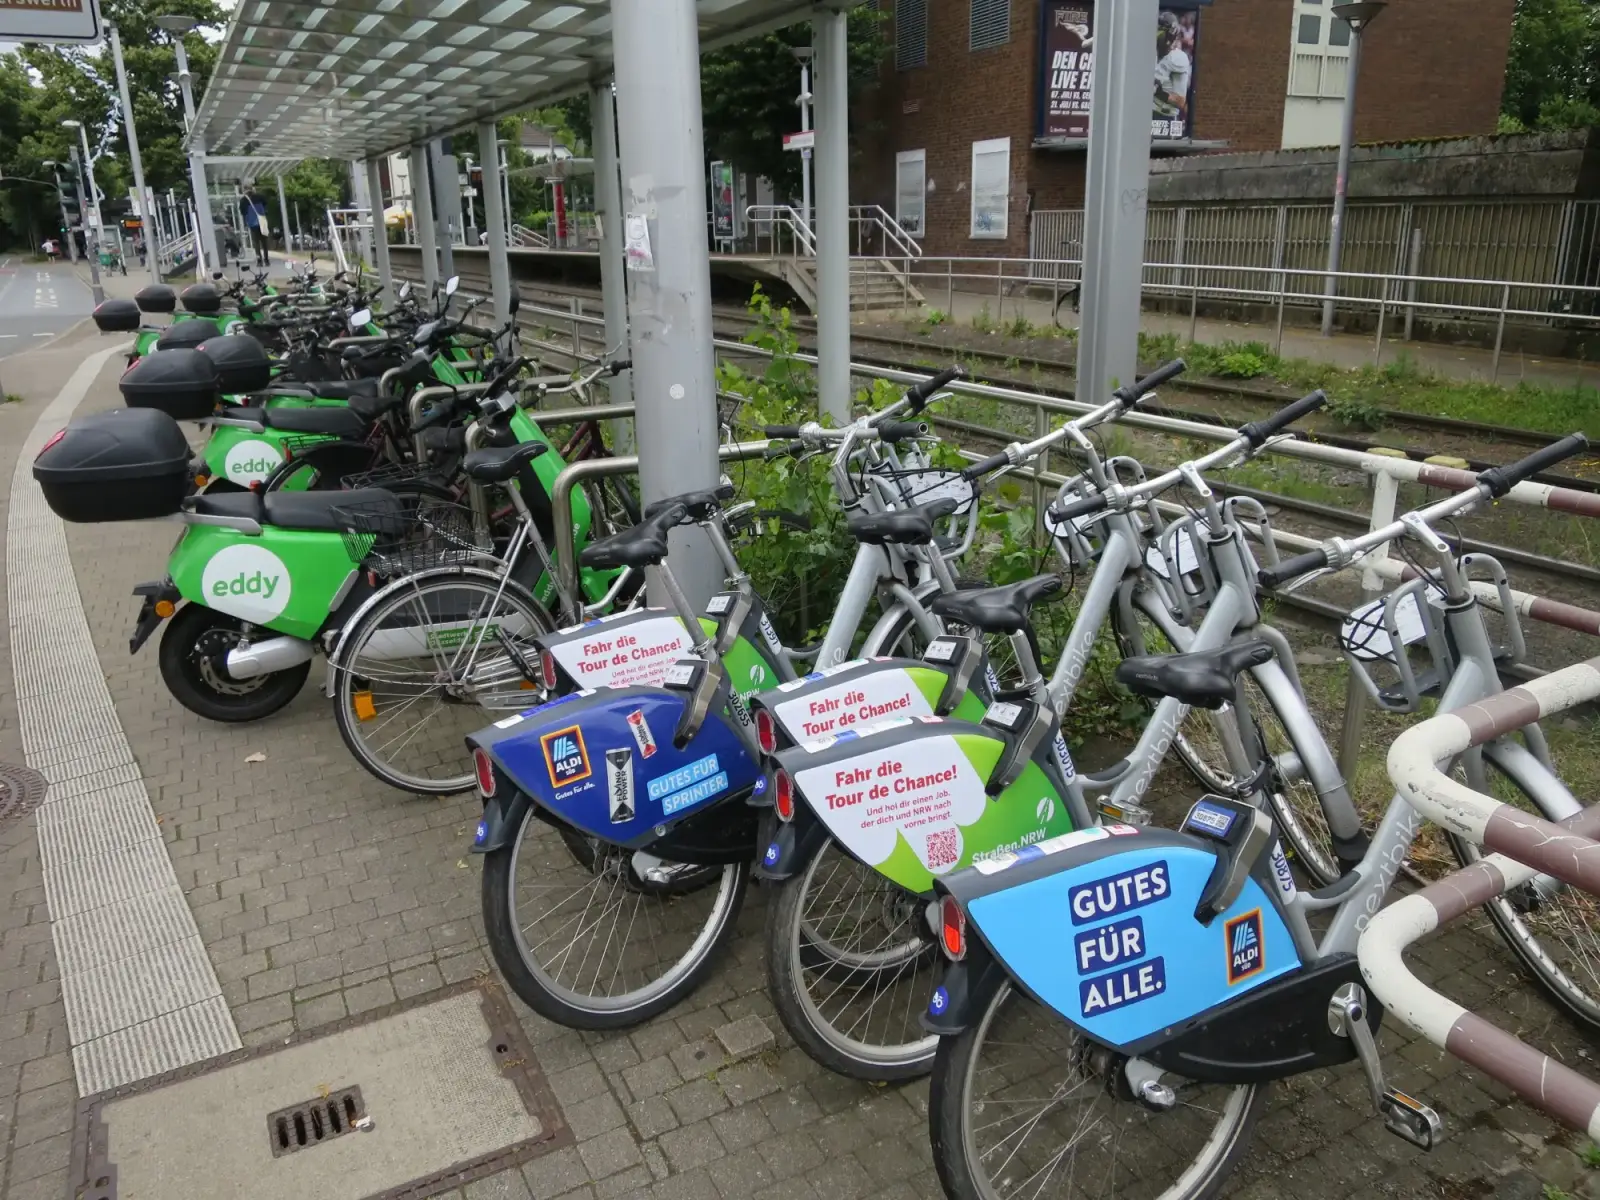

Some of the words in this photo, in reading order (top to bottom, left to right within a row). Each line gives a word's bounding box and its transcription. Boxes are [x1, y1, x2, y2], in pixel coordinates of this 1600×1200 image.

[1052, 51, 1078, 69] DEN
[1051, 70, 1079, 89] LIVE
[231, 458, 277, 476] eddy
[212, 570, 279, 599] eddy
[583, 641, 612, 656] Fahr
[616, 636, 637, 648] die
[761, 620, 779, 645] 31391
[577, 660, 608, 674] Tour
[612, 654, 628, 666] de
[631, 638, 682, 660] Chance!
[1055, 631, 1095, 716] extbike
[728, 691, 751, 727] 302655
[802, 719, 835, 736] Tour
[838, 713, 856, 726] de
[859, 693, 911, 720] Chance!
[809, 699, 840, 716] Fahr
[844, 691, 865, 706] die
[556, 756, 582, 773] ALDI
[1054, 738, 1074, 779] 303015
[650, 770, 691, 797] GUTES
[693, 758, 717, 778] FÜR
[825, 791, 864, 810] Tour
[868, 784, 889, 800] de
[893, 764, 958, 793] Chance!
[835, 768, 872, 787] Fahr
[877, 760, 903, 777] die
[555, 790, 573, 800] Gutes
[664, 775, 728, 812] SPRINTER.
[866, 807, 884, 816] Und
[899, 799, 910, 808] dir
[912, 795, 934, 805] einen
[860, 820, 874, 829] der
[876, 815, 894, 825] dich
[896, 811, 912, 820] und
[913, 804, 932, 816] NRW
[934, 800, 952, 810] nach
[904, 818, 927, 829] vorne
[928, 810, 953, 823] bringt.
[1272, 853, 1293, 892] 30875
[1073, 867, 1167, 919] GUTES
[1079, 926, 1141, 969] FÜR
[1233, 946, 1258, 968] ALDI
[1083, 965, 1162, 1013] ALLE.
